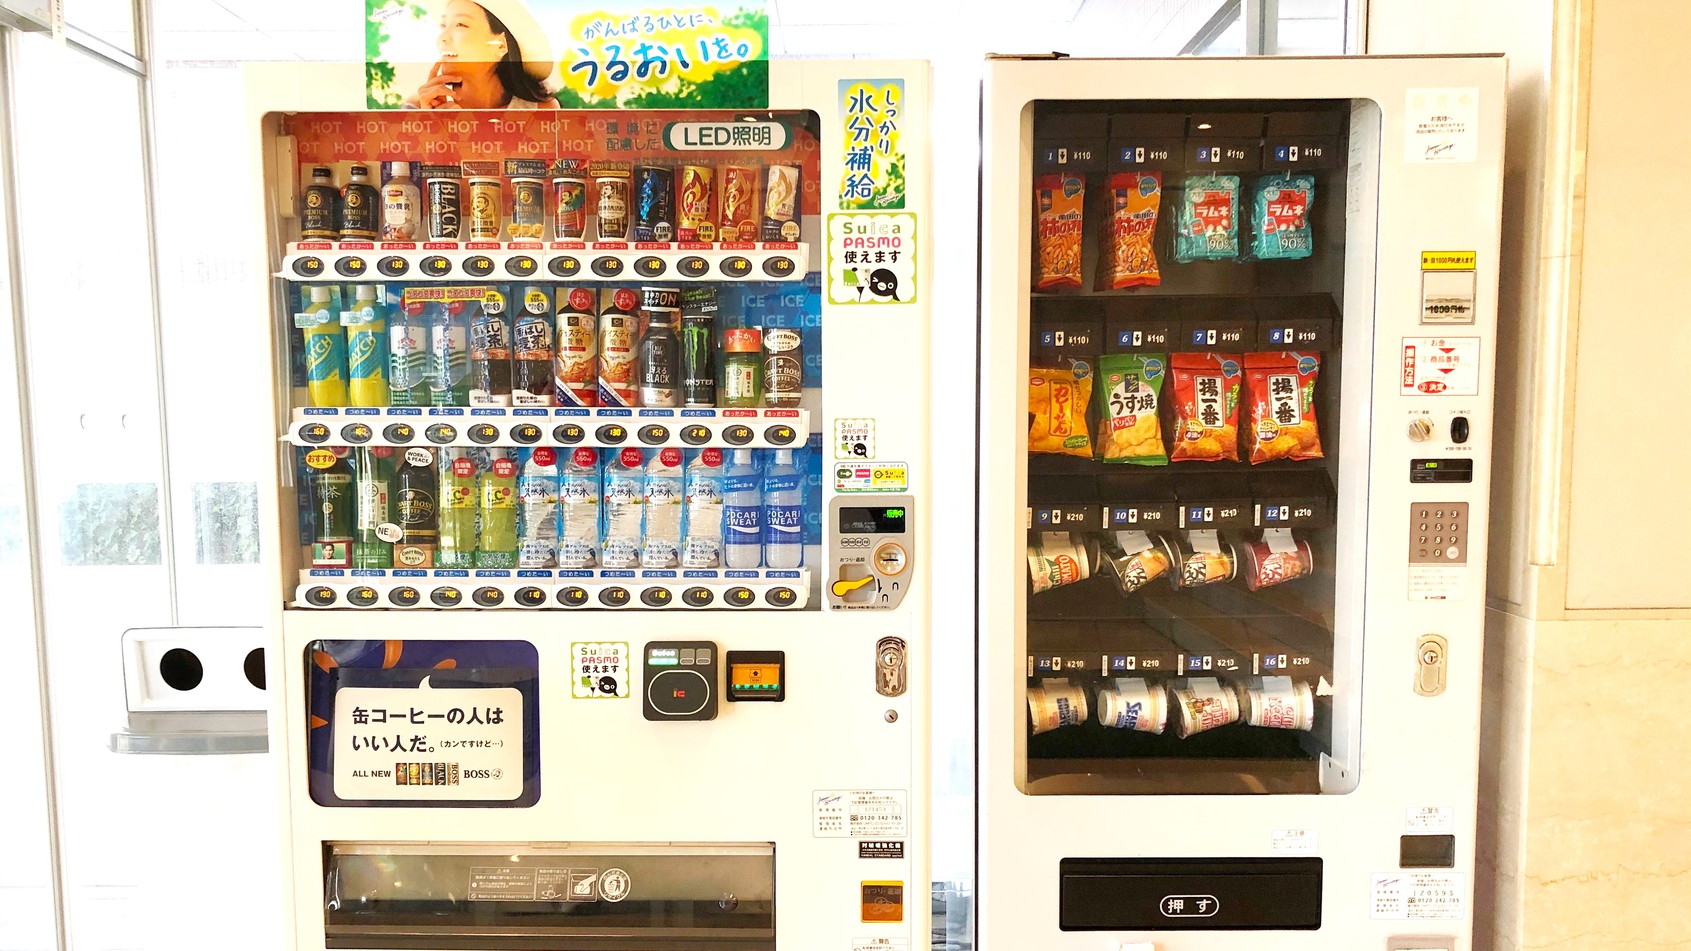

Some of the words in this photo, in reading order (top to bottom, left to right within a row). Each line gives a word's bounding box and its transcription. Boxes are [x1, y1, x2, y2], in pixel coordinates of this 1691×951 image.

[584, 14, 713, 39] がんばるひとに、
[571, 37, 749, 87] うるおいを。
[402, 121, 433, 133] HOT
[448, 121, 479, 133] HOT
[494, 121, 526, 133] HOT
[540, 120, 570, 132] HOT
[878, 89, 897, 155] しっかり
[684, 126, 771, 147] LED照明
[334, 142, 365, 153] HOT
[380, 142, 411, 153] HOT
[425, 142, 457, 153] HOT
[471, 142, 503, 153] HOT
[518, 142, 549, 153] HOT
[562, 140, 594, 151] HOT
[844, 88, 878, 198] 水分補給
[1047, 152, 1053, 160] 1
[1073, 151, 1091, 160] ¥110
[1150, 151, 1167, 160] ¥110
[1200, 151, 1207, 159] 3
[1227, 150, 1244, 159] ¥110
[1278, 150, 1285, 158] 4
[1304, 148, 1322, 157] ¥110
[507, 161, 517, 174] 新
[554, 160, 579, 169] NEW
[440, 184, 458, 238] BLACK
[1196, 206, 1229, 217] ラムネ
[1270, 204, 1304, 216] ラムネ
[843, 222, 901, 235] Suica
[843, 236, 902, 249] PASMO
[1281, 238, 1307, 249] 90%
[844, 250, 902, 264] 使えます
[660, 292, 676, 305] ON
[742, 296, 765, 307] ICE
[781, 295, 804, 307] ICE
[762, 315, 785, 327] ICE
[801, 315, 822, 327] ICE
[1045, 335, 1050, 343] 5
[1068, 336, 1086, 345] ¥110
[1122, 334, 1128, 343] 6
[1147, 335, 1164, 343] ¥110
[1196, 333, 1202, 342] 7
[1222, 333, 1240, 341] ¥110
[1273, 332, 1280, 340] 8
[1298, 332, 1316, 341] ¥110
[645, 374, 670, 383] BLACK
[1110, 393, 1155, 415] うす焼
[1199, 378, 1219, 425] 揚一番
[1272, 378, 1295, 424] 揚一番
[307, 454, 335, 463] おすすめ
[726, 511, 759, 519] POCARI
[767, 510, 800, 518] POCARI
[1041, 512, 1048, 521] 9
[1066, 513, 1084, 522] ¥210
[1115, 511, 1127, 520] 10
[1143, 511, 1161, 520] ¥210
[1191, 511, 1202, 519] 11
[1220, 509, 1237, 518] ¥210
[1266, 509, 1278, 517] 12
[1294, 508, 1312, 517] ¥210
[581, 656, 619, 664] PASMO
[1039, 659, 1050, 667] 13
[1067, 659, 1084, 668] ¥210
[1113, 659, 1125, 667] 14
[1142, 659, 1159, 668] ¥210
[1190, 659, 1200, 667] 15
[1217, 658, 1235, 667] ¥210
[1265, 658, 1276, 666] 16
[1293, 657, 1310, 666] ¥210
[582, 665, 619, 674] 使えます
[352, 706, 504, 725] 缶コーヒーの人は
[352, 734, 435, 753] いい人だ。
[352, 770, 369, 778] ALL
[371, 770, 391, 778] NEW
[463, 769, 490, 779] BOSS
[1168, 898, 1212, 913] 押す
